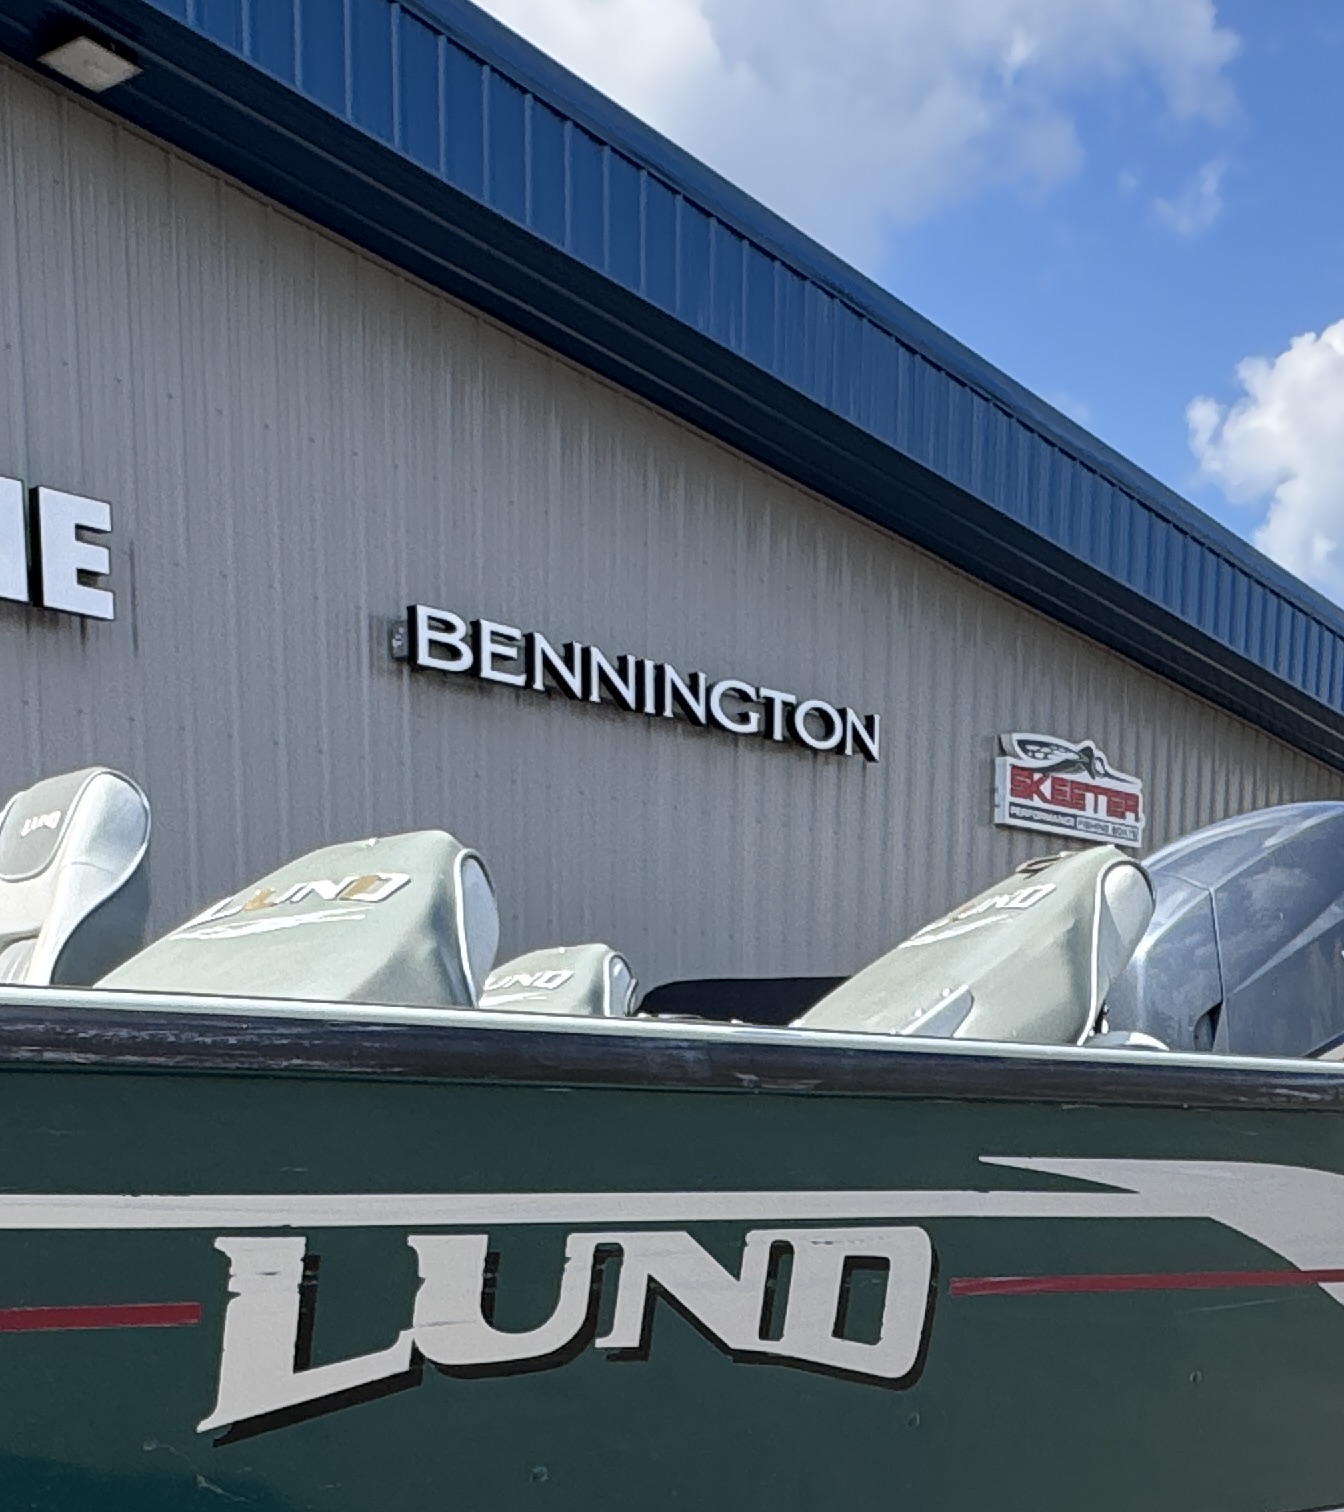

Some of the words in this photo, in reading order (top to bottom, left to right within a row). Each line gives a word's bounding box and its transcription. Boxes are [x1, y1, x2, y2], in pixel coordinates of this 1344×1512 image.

[409, 604, 881, 762] BENNINGTON
[1010, 766, 1139, 821] SKEETER
[178, 872, 412, 932] LUND
[483, 970, 575, 992] UND
[197, 1225, 936, 1436] LUND
